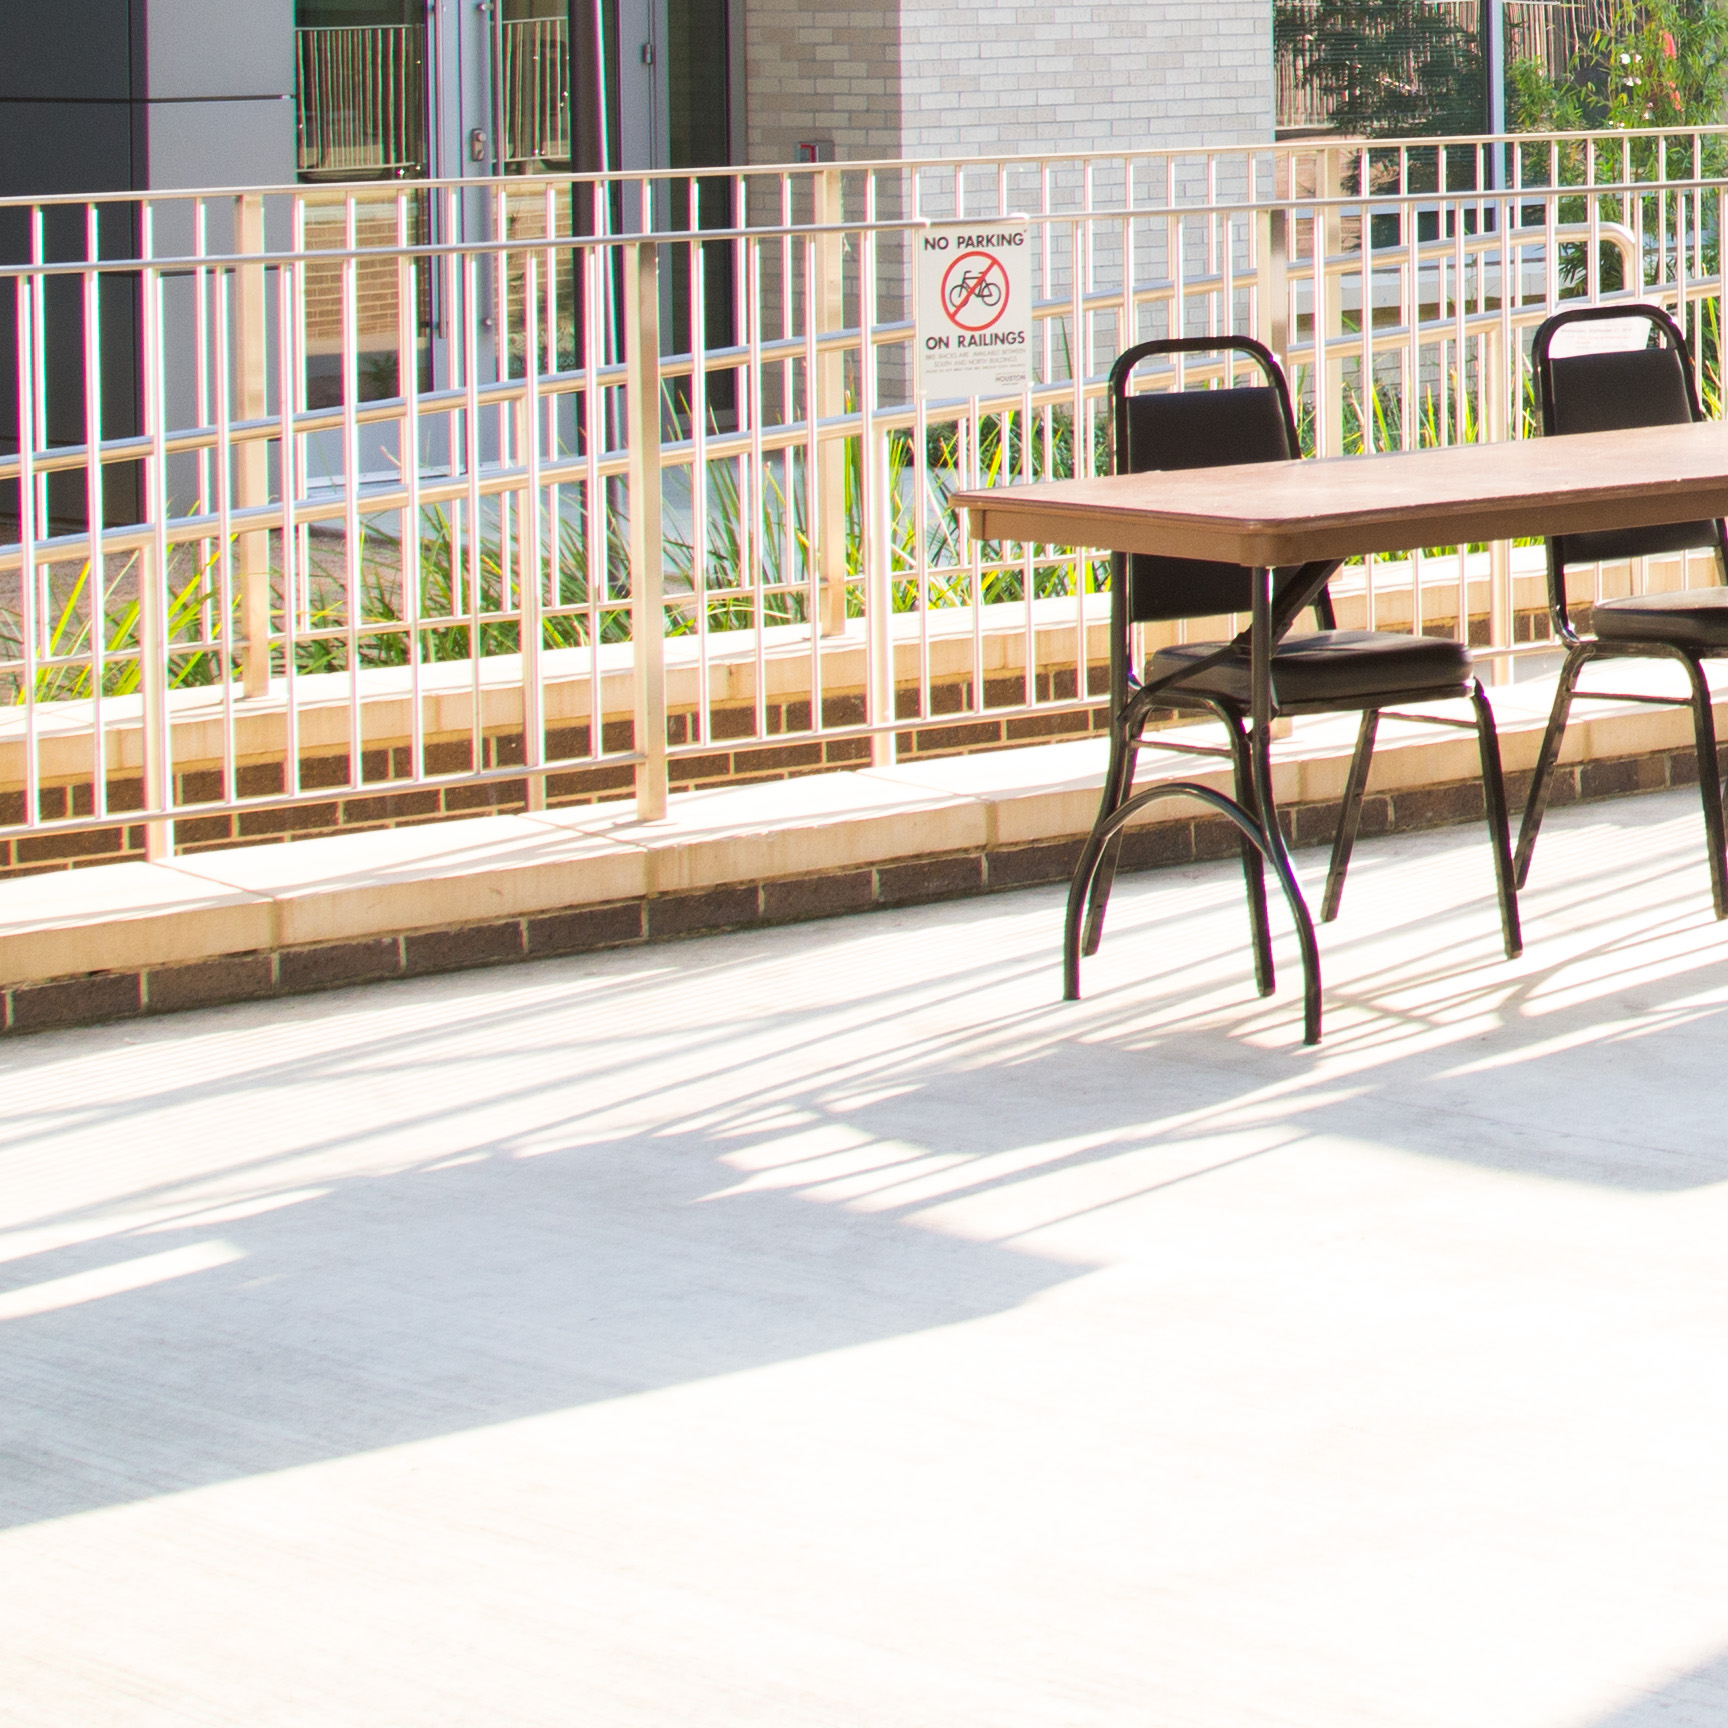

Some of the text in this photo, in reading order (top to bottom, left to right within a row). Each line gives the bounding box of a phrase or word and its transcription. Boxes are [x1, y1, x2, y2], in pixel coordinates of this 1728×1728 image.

[924, 232, 1025, 251] NO PARKING
[926, 331, 1025, 350] ON RAILINGS
[995, 374, 1026, 383] HOUSTON
